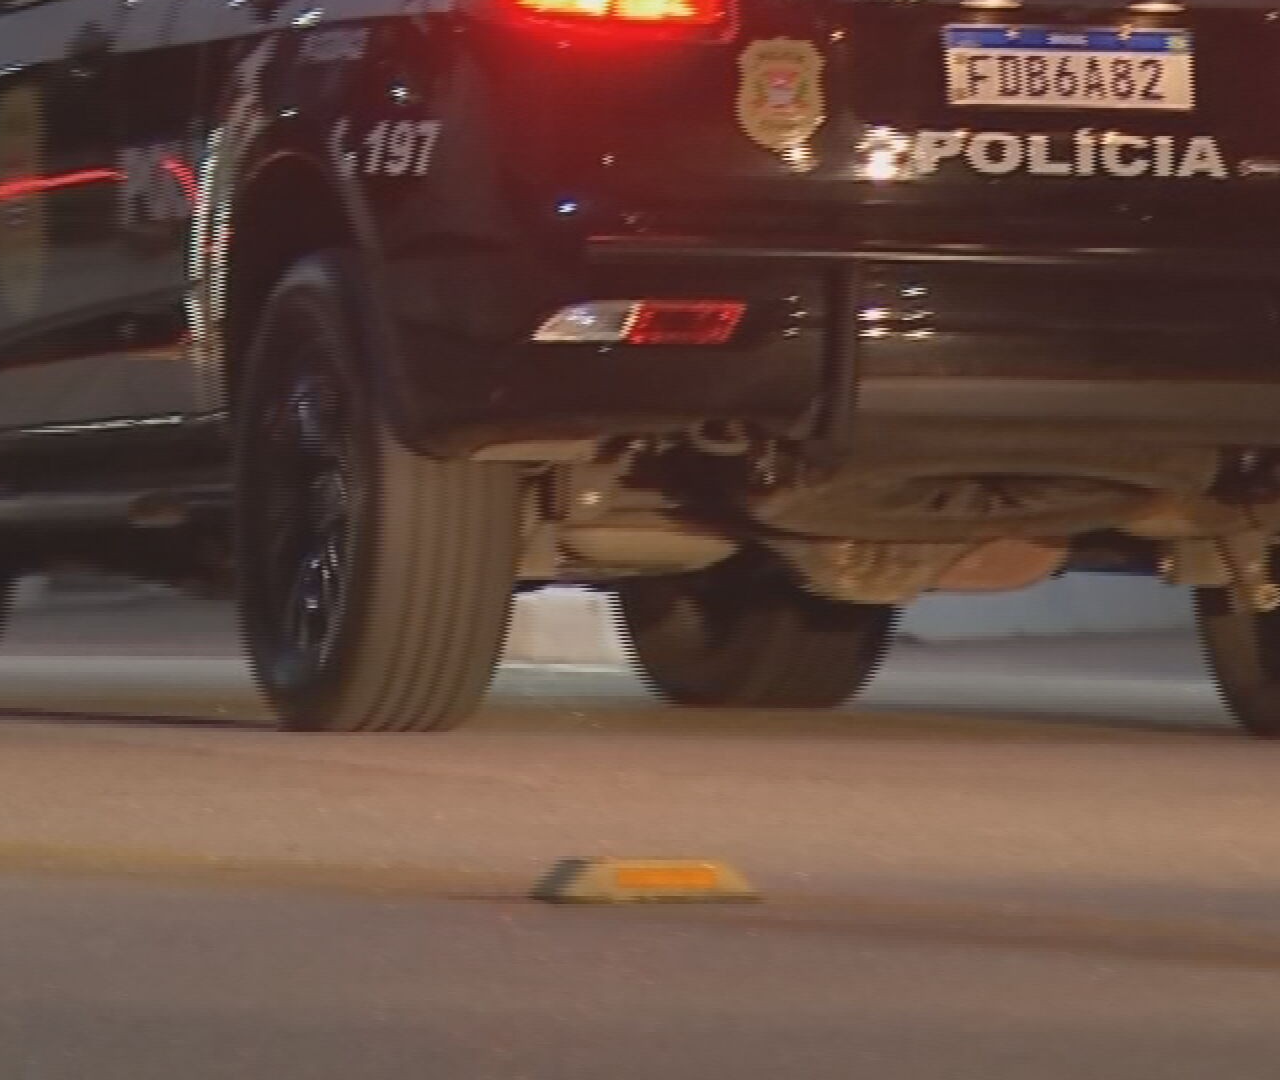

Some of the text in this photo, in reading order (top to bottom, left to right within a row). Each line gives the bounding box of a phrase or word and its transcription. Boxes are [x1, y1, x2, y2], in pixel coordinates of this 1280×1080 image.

[967, 55, 1166, 100] FDB6A82
[361, 120, 441, 176] 197
[914, 128, 1227, 178] POLÍCIA
